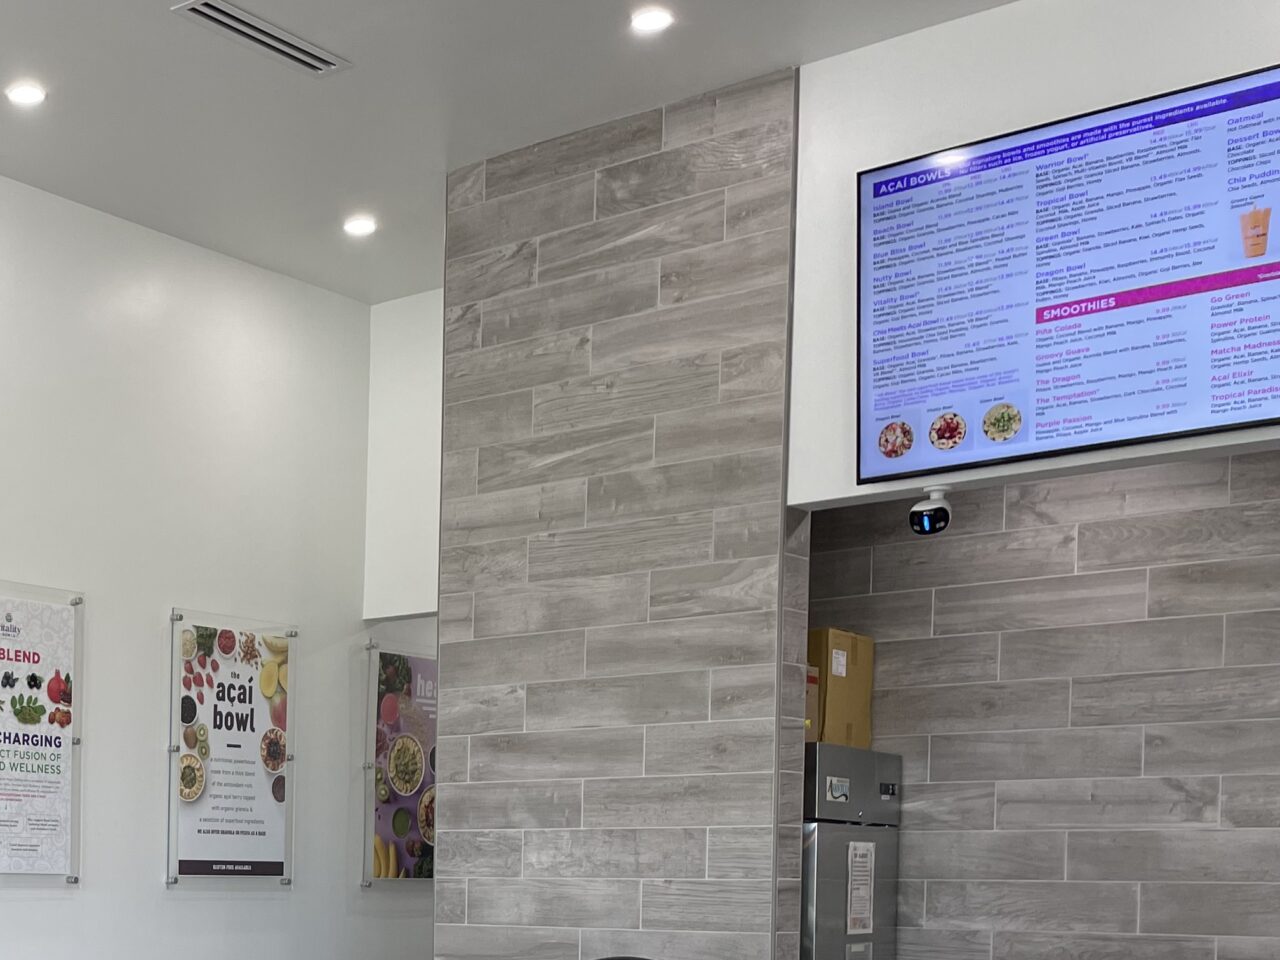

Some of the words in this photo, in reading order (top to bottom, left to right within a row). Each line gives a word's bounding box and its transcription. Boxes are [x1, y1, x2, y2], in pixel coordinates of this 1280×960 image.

[1155, 106, 1194, 121] ingredients
[1228, 112, 1264, 125] Oatmeal
[1228, 132, 1259, 146] Dessert
[1036, 160, 1064, 171] Warrior
[910, 168, 950, 188] BOWLS
[1228, 176, 1247, 185] Chia
[1250, 169, 1280, 181] Puddin
[873, 201, 893, 211] Island
[896, 197, 913, 206] Bowl
[1036, 194, 1067, 207] Tropical
[1069, 190, 1089, 200] Bowl
[873, 226, 894, 236] Beach
[896, 221, 914, 230] Bowl
[1036, 234, 1059, 244] Green
[1061, 229, 1080, 239] Bowl
[873, 251, 888, 260] Blue
[890, 247, 906, 256] Bliss
[908, 242, 925, 251] Bowl
[873, 275, 892, 284] Nutty
[895, 270, 912, 279] Bowl
[1036, 268, 1064, 279] Dragon
[1066, 263, 1086, 273] Bowl
[873, 296, 898, 308] Vitality
[1210, 296, 1223, 304] Go
[1225, 292, 1250, 301] Green
[1043, 297, 1116, 320] SMOOTHIES
[873, 328, 887, 337] Chia
[888, 324, 907, 333] Meets
[923, 316, 939, 326] Bowl
[1054, 322, 1082, 333] Colada
[1210, 320, 1237, 330] Power
[1240, 314, 1270, 325] Protein
[873, 353, 910, 365] Superfood
[911, 350, 929, 359] Bowl
[1036, 352, 1063, 362] Groovy
[1066, 347, 1090, 357] Guava
[1210, 346, 1242, 356] Matcha
[1036, 378, 1050, 386] The
[1052, 374, 1081, 385] Dragon
[1232, 370, 1254, 379] Elixir
[1212, 390, 1245, 401] Tropical
[1036, 420, 1061, 429] Purple
[1063, 414, 1092, 425] Passion
[230, 672, 240, 680] the
[216, 676, 254, 707] açaí
[213, 704, 256, 733] bowl
[14, 750, 47, 761] FUSION
[49, 752, 62, 762] OF
[9, 762, 62, 775] WELLNESS
